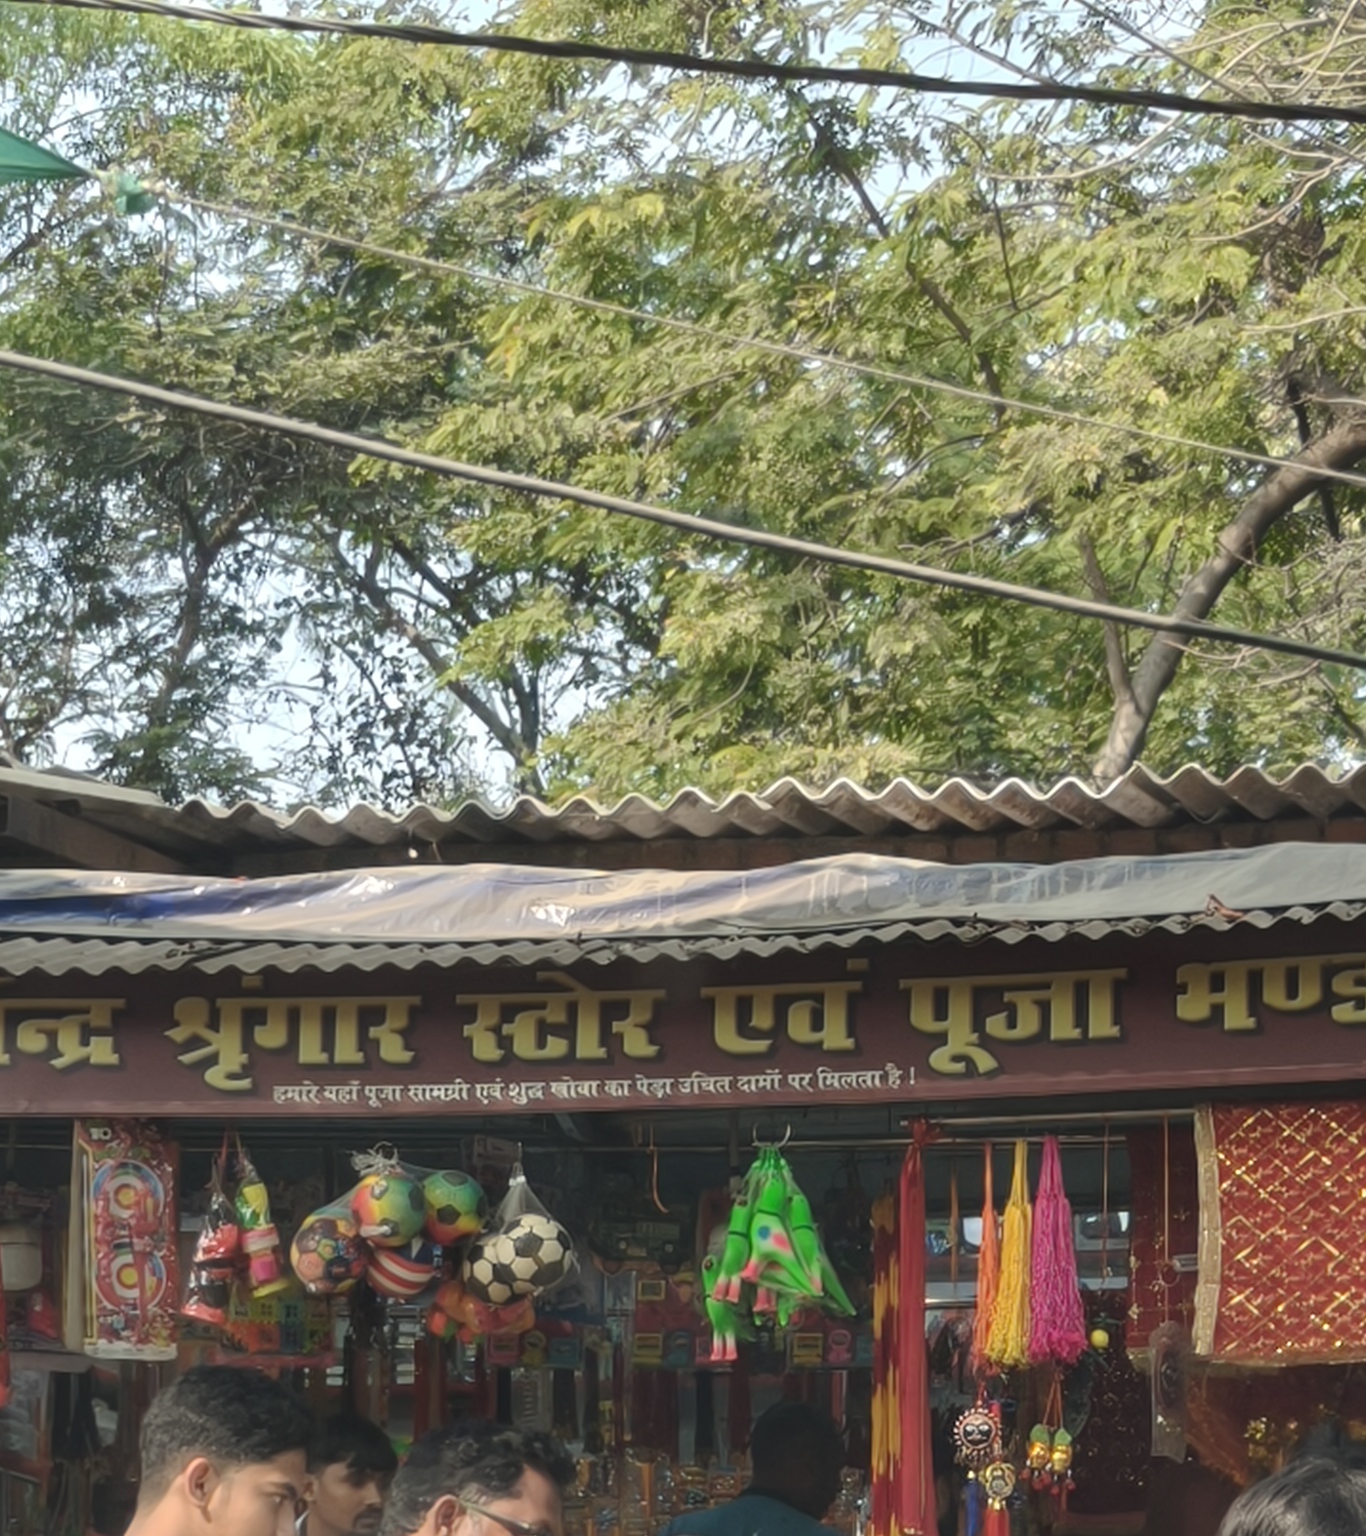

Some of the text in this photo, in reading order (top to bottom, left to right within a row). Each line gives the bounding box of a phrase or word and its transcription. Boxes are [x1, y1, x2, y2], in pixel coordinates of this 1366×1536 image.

[455, 971, 667, 1063] स्टोर
[700, 958, 870, 1055] एवं
[899, 967, 1129, 1075] पूजा
[272, 1081, 320, 1104] हमारे
[364, 1084, 402, 1108] पूजा
[475, 1077, 506, 1104] एवं
[604, 1078, 630, 1098] का
[678, 1070, 733, 1095] उचित
[787, 1072, 815, 1094] पर
[817, 1066, 885, 1091] मिलता
[886, 1063, 904, 1089] है
